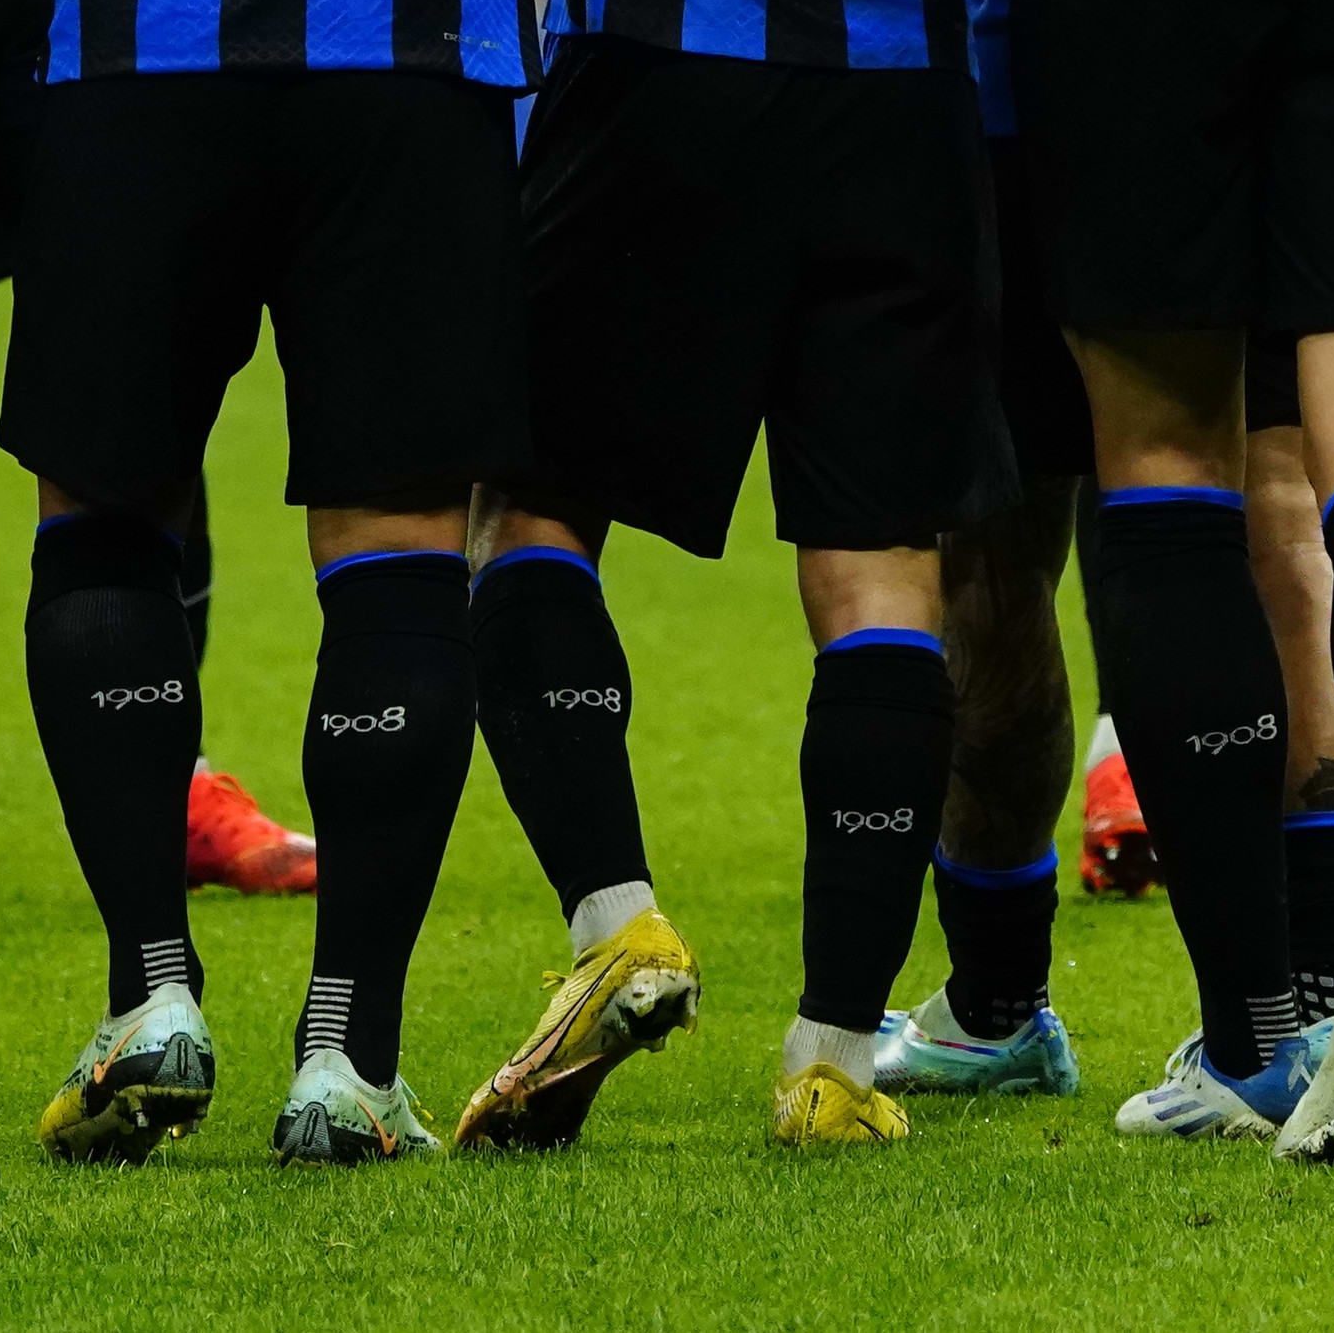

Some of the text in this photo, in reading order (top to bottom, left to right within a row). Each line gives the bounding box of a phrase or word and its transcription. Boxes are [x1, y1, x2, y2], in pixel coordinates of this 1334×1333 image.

[90, 679, 184, 711] 1908
[542, 687, 622, 714] 1908
[320, 705, 406, 737] 1908
[1185, 713, 1278, 756] 1908
[832, 807, 915, 834] 1908
